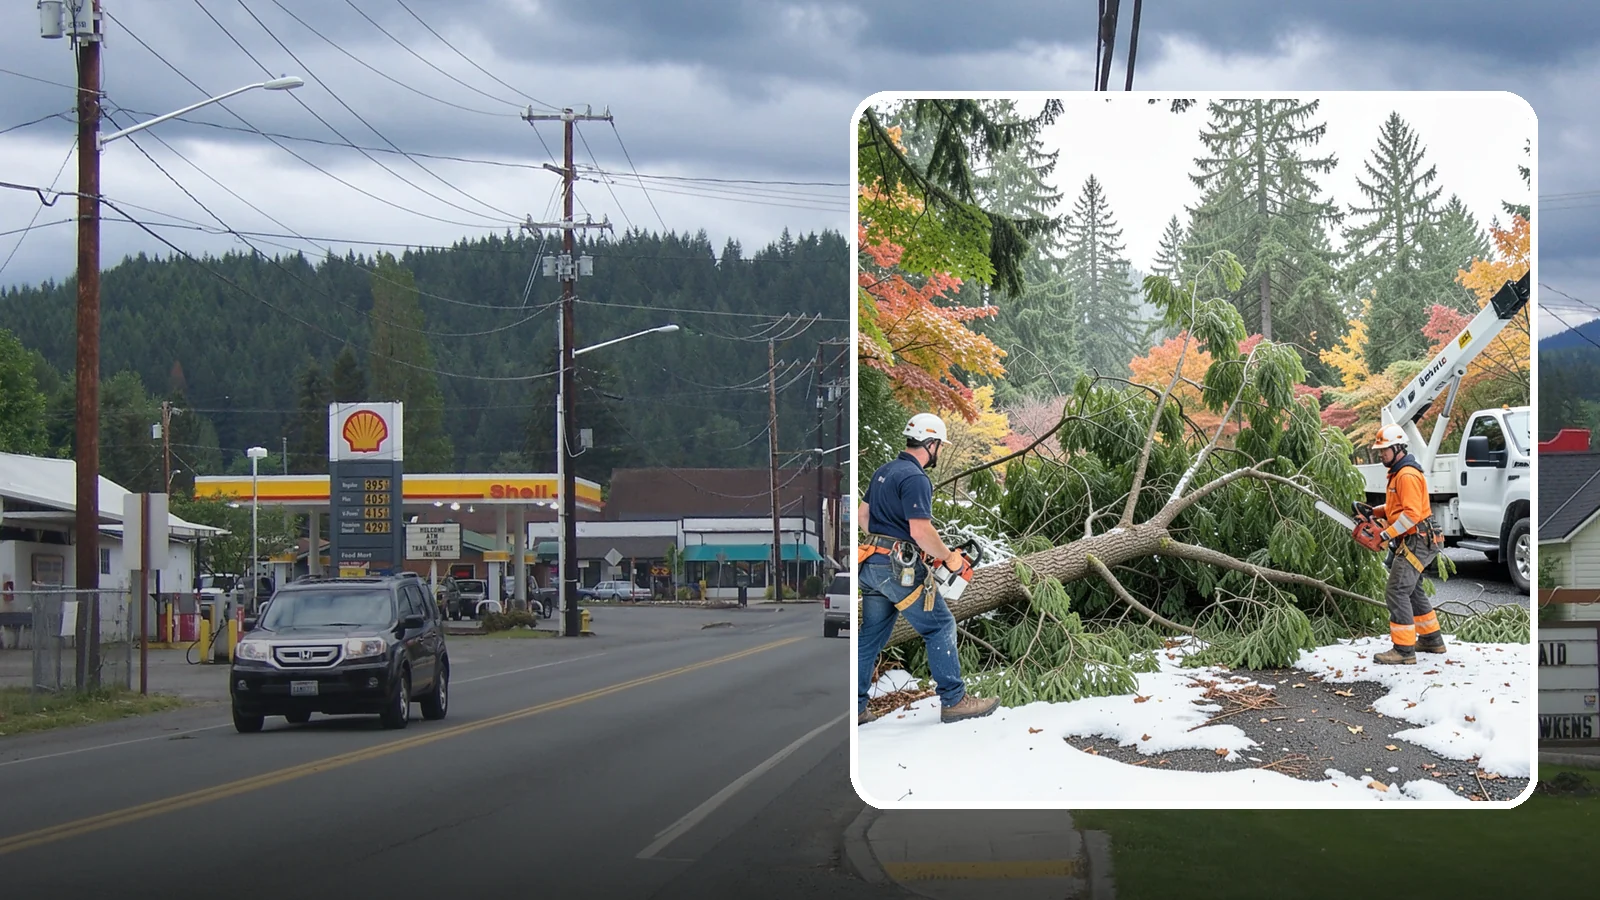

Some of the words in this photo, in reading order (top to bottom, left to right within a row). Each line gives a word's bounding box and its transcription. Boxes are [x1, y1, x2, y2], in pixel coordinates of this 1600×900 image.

[366, 480, 383, 490] 395
[490, 484, 547, 499] Shell
[366, 494, 383, 504] 405
[366, 508, 383, 518] 415
[366, 522, 383, 532] 429
